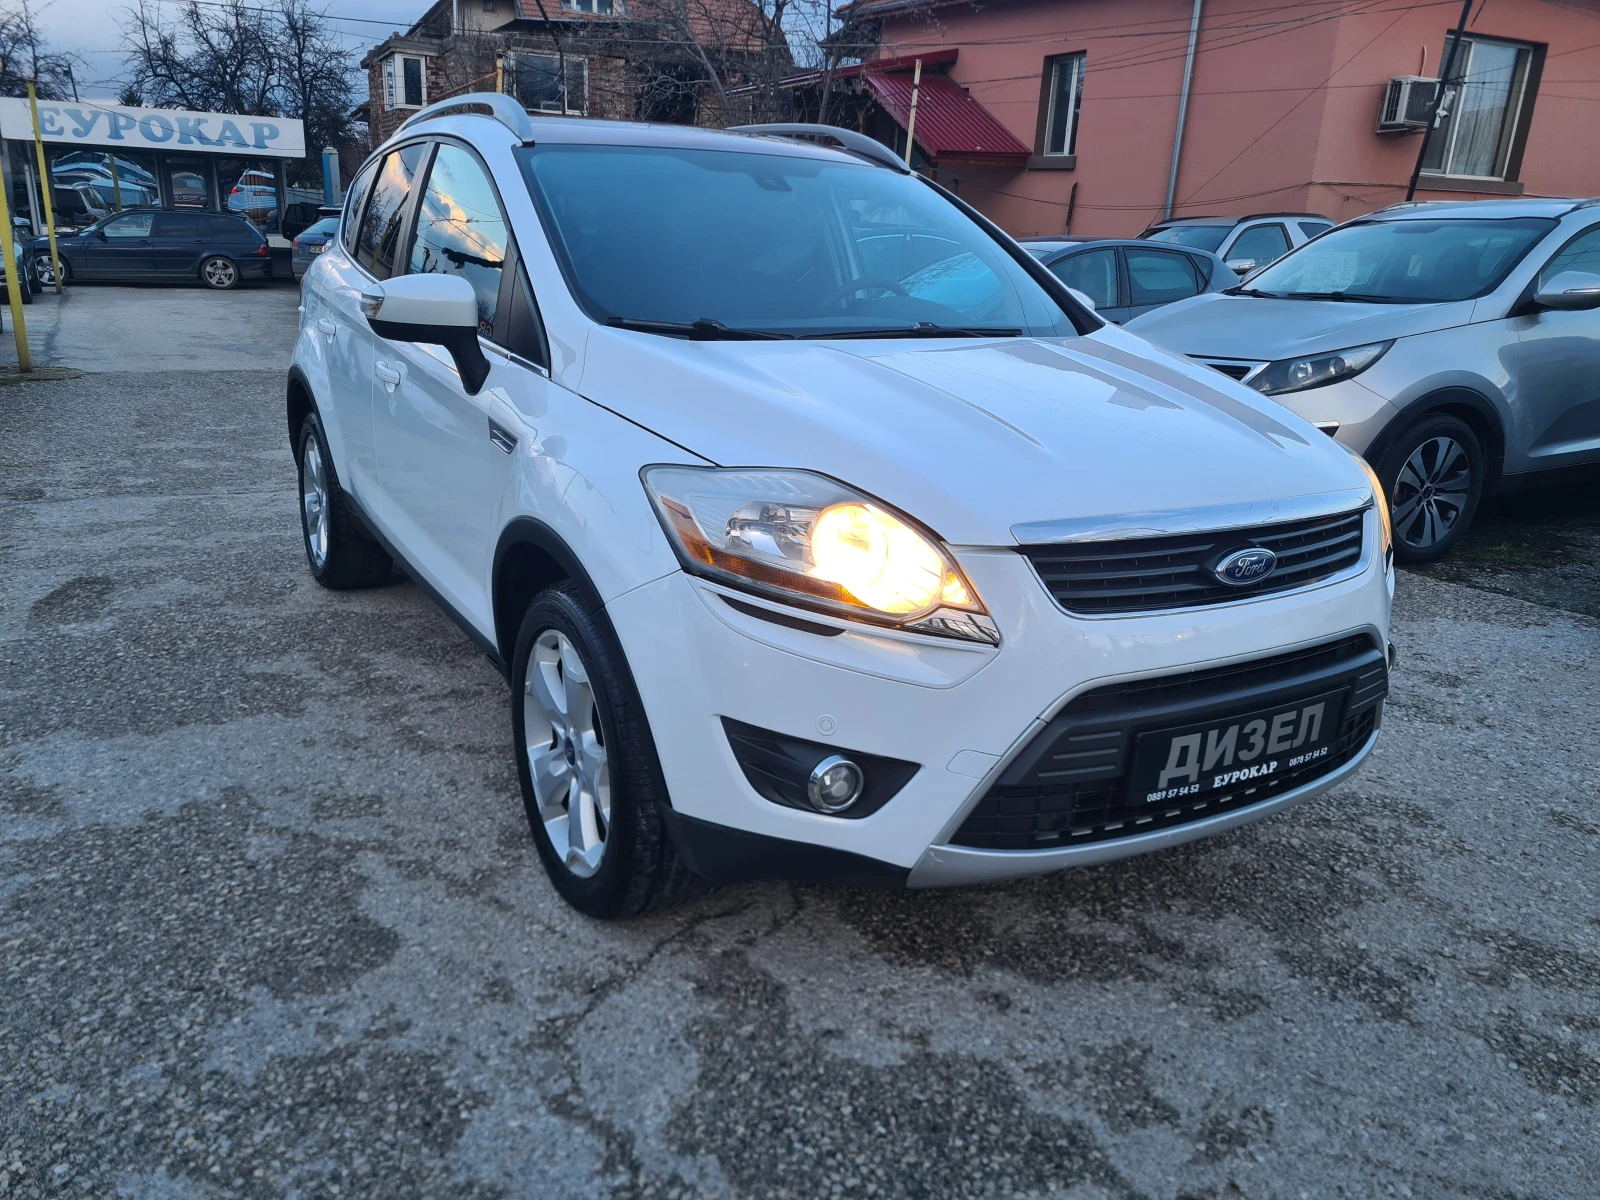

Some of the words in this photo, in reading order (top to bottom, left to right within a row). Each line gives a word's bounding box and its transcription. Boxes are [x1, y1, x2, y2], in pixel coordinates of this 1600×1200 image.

[31, 106, 280, 149] ЕУРОКАР
[1235, 556, 1266, 577] Ford
[1158, 702, 1326, 789] ДИЗЕЛ
[1304, 752, 1312, 761] 57
[1320, 747, 1328, 756] 52
[1212, 761, 1278, 788] ЕУРОКАР
[1146, 790, 1167, 802] 0889
[1167, 788, 1178, 798] 57
[1178, 786, 1189, 796] 54
[1189, 784, 1200, 793] 52
